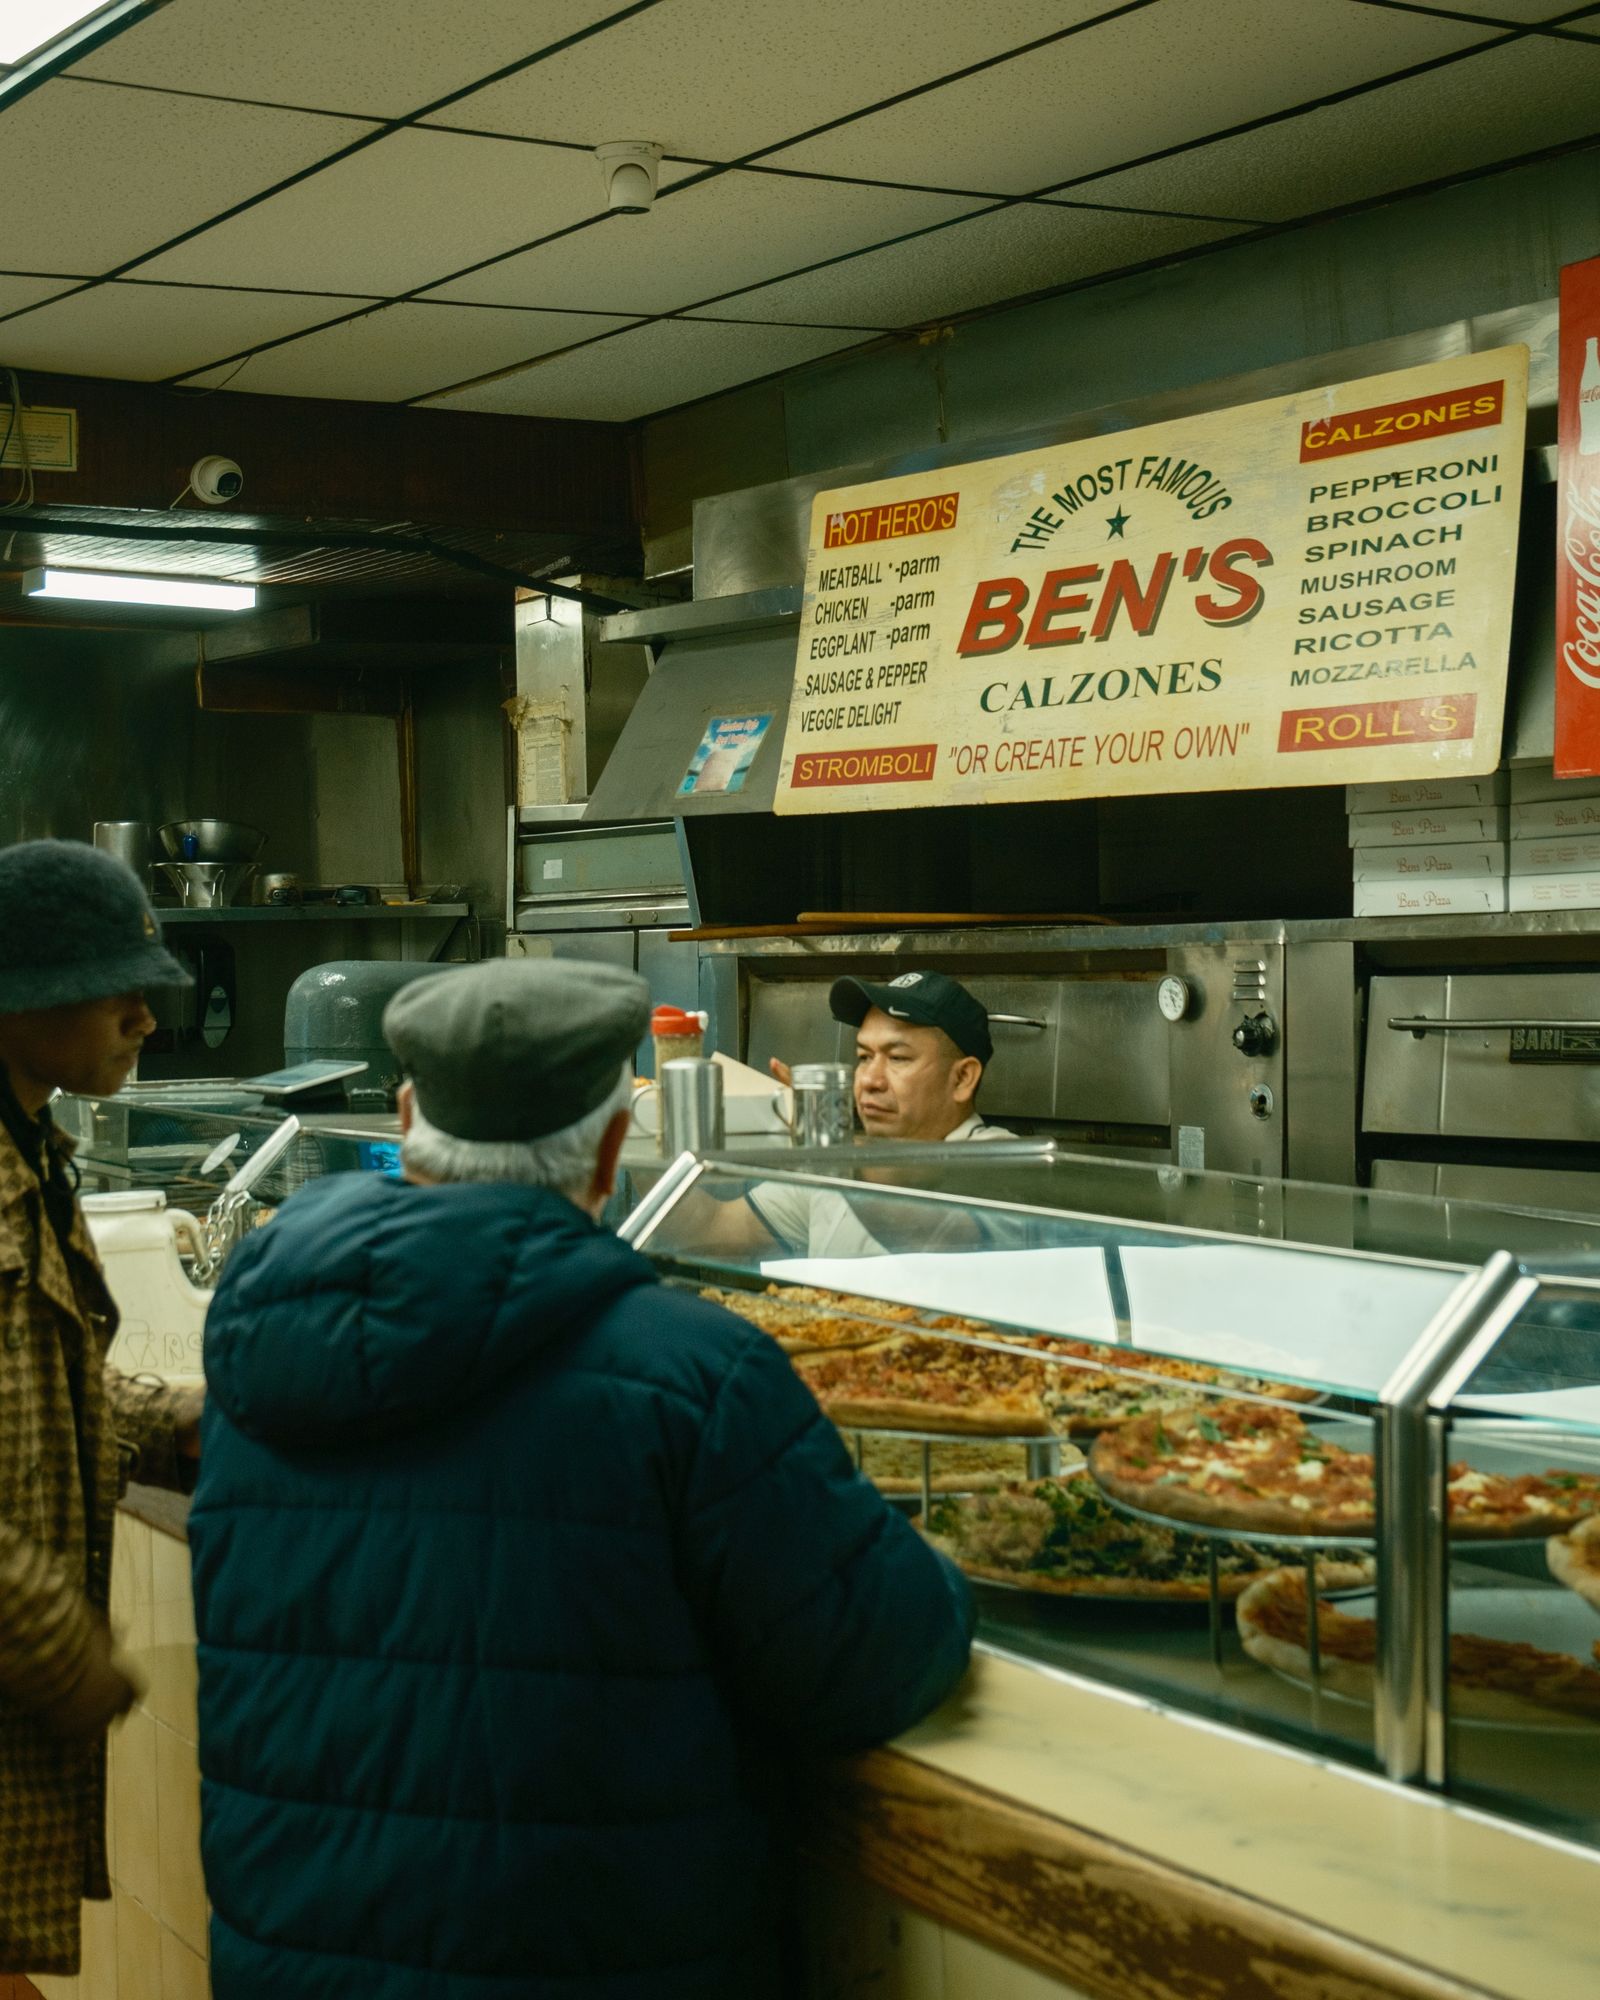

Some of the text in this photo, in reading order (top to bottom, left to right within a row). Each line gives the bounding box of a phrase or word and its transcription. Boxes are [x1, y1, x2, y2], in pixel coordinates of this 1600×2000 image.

[1304, 395, 1496, 449] CALZONES
[1309, 454, 1498, 504] PEPPERONI
[828, 497, 956, 547] HOT HERO'S
[1010, 455, 1233, 553] THE MOST FAMOUS
[1306, 485, 1502, 533] BROCCOLI
[1304, 523, 1463, 563] SPINACH
[818, 555, 940, 592] MEATBALL -parm
[1300, 557, 1457, 595] MUSHROOM
[815, 590, 935, 625] CHICKEN -parm
[956, 537, 1273, 659] BEN'S
[1297, 589, 1456, 624] SAUSAGE
[810, 623, 931, 660] EGGPLANT -parm
[1293, 622, 1453, 655] RICOTTA
[805, 661, 927, 697] SAUSAGE & PEPPER
[980, 658, 1222, 713] CALZONES
[1290, 652, 1477, 687] MOZZARELLA
[801, 701, 902, 733] VEGGIE DELIGHT
[1294, 704, 1458, 744] ROLL'S
[800, 752, 932, 780] STROMBOLI
[994, 736, 1087, 773] CREATE
[1094, 729, 1165, 765] YOUR
[1174, 722, 1250, 760] OWN"
[1513, 1028, 1560, 1050] BARI
